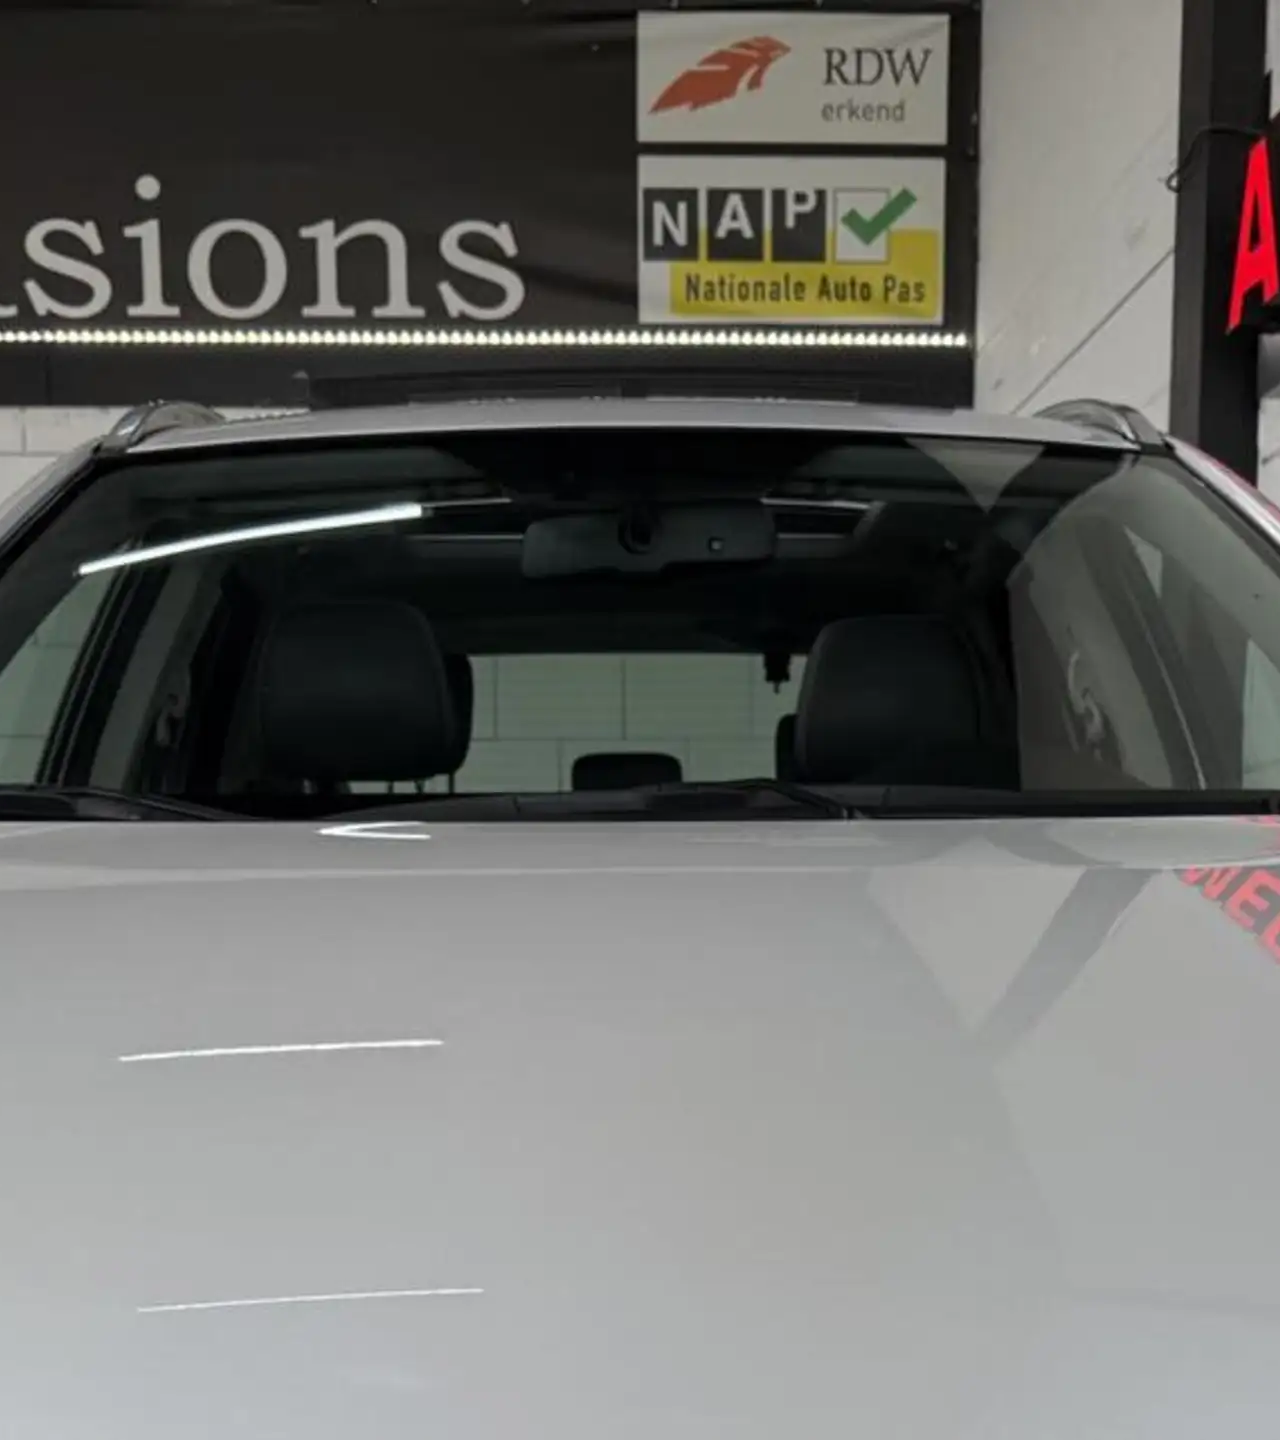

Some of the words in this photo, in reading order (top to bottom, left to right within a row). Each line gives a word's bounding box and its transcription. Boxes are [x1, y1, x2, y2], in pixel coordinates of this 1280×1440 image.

[822, 47, 933, 88] RDW
[821, 97, 906, 124] erkend
[653, 188, 817, 247] NAP
[686, 273, 806, 304] Nationale
[819, 274, 872, 303] Auto
[884, 276, 926, 305] Pas
